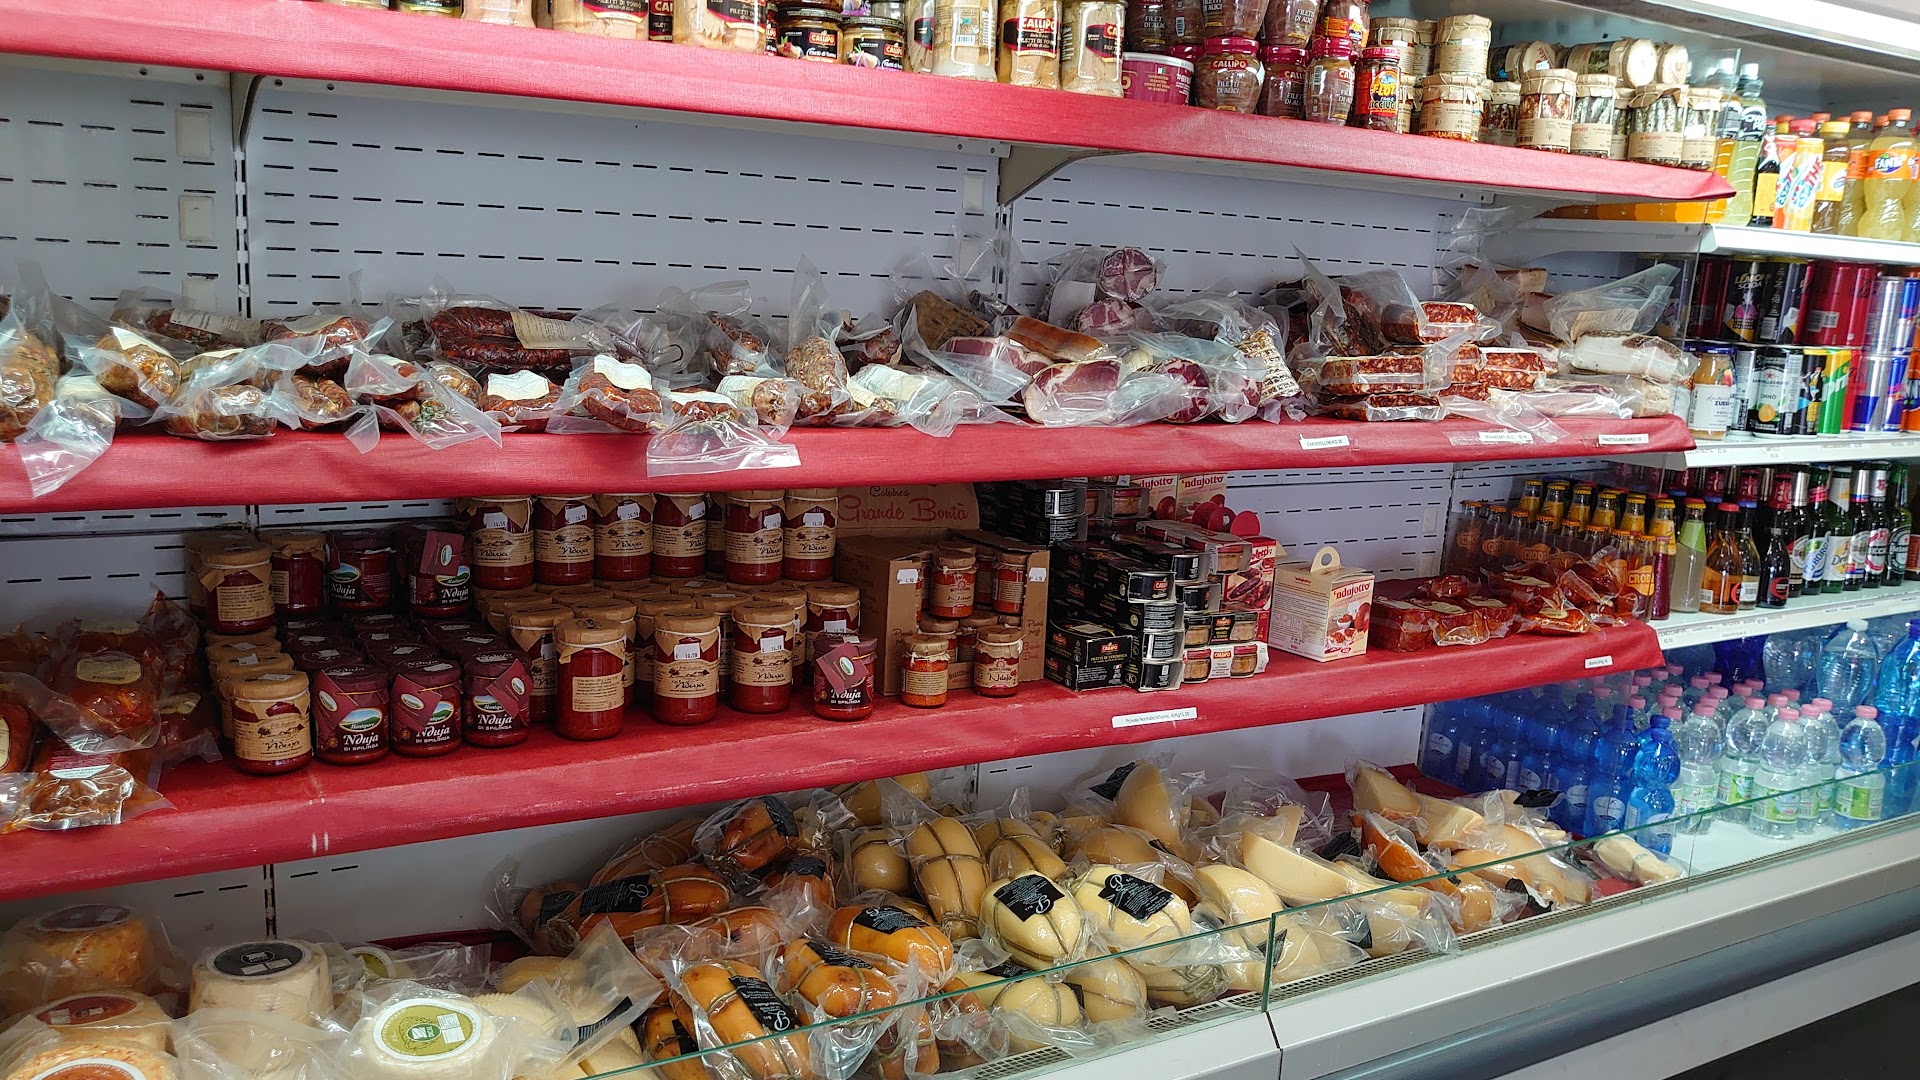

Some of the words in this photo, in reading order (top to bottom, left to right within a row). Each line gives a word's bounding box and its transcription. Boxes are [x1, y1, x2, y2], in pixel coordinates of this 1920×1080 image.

[1213, 60, 1247, 69] CALLIPO
[1373, 83, 1395, 97] FLOT
[838, 494, 905, 523] Grande
[908, 497, 969, 522] Bontà
[477, 714, 513, 727] 'Nduja
[343, 731, 380, 746] 'Nduja
